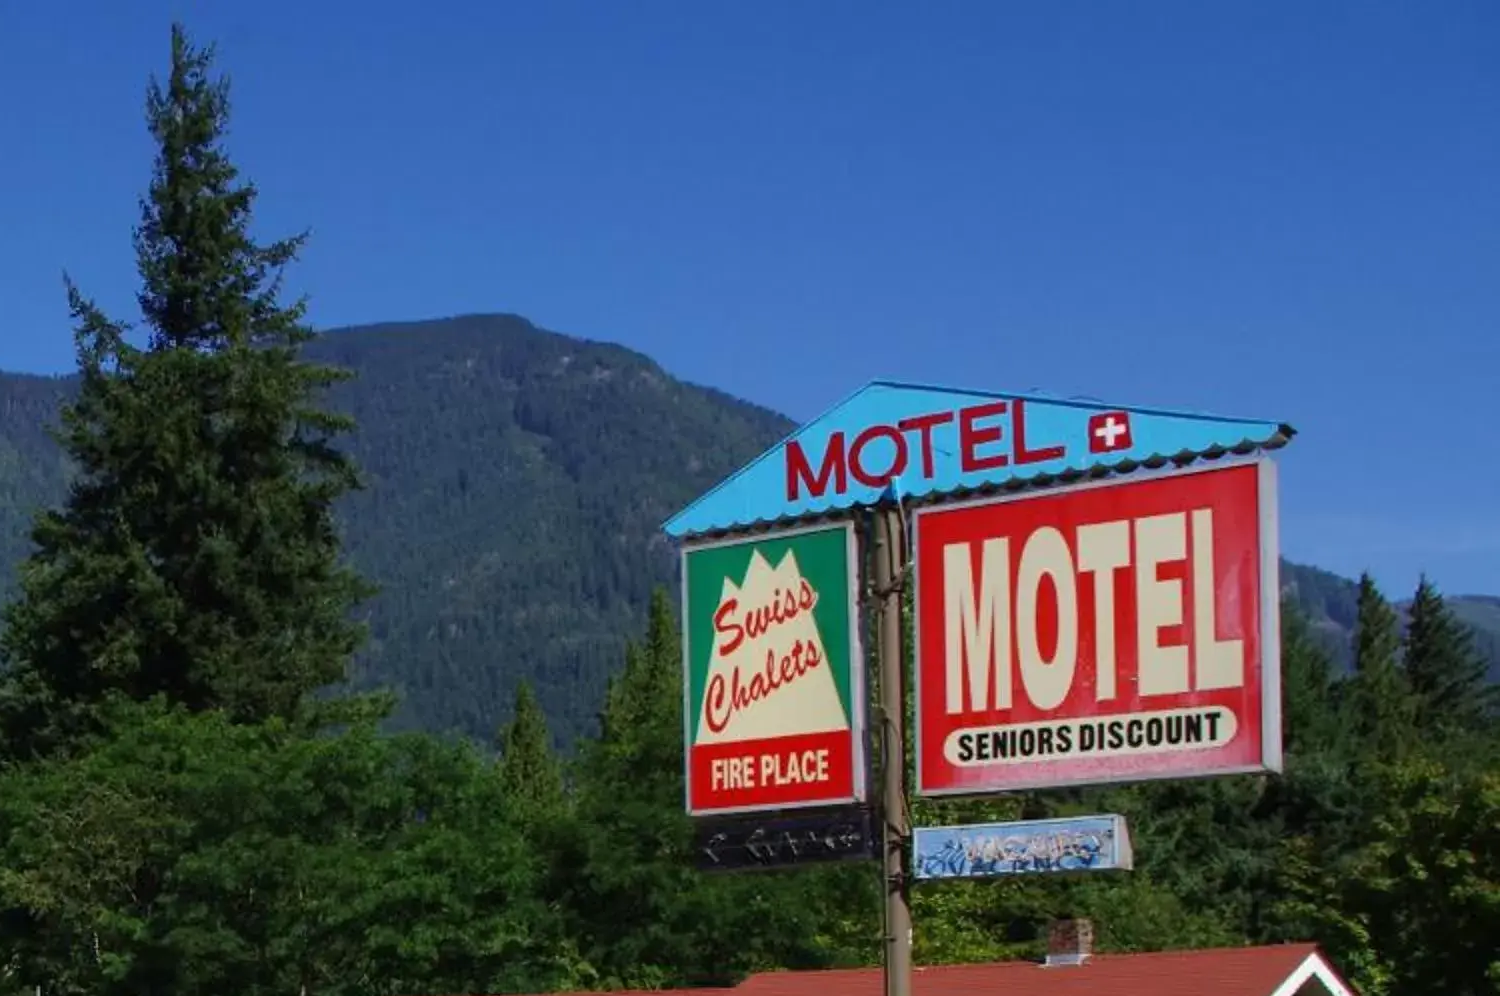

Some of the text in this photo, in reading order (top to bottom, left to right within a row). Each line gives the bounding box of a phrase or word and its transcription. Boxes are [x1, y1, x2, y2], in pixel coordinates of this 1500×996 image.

[785, 399, 1065, 502] MOTEL
[713, 579, 816, 657] Swiss
[942, 508, 1245, 715] MOTEL
[705, 639, 822, 733] Chalets
[711, 749, 830, 792] FIRE PLACE
[957, 712, 1222, 762] SENIORS DISCOUNT
